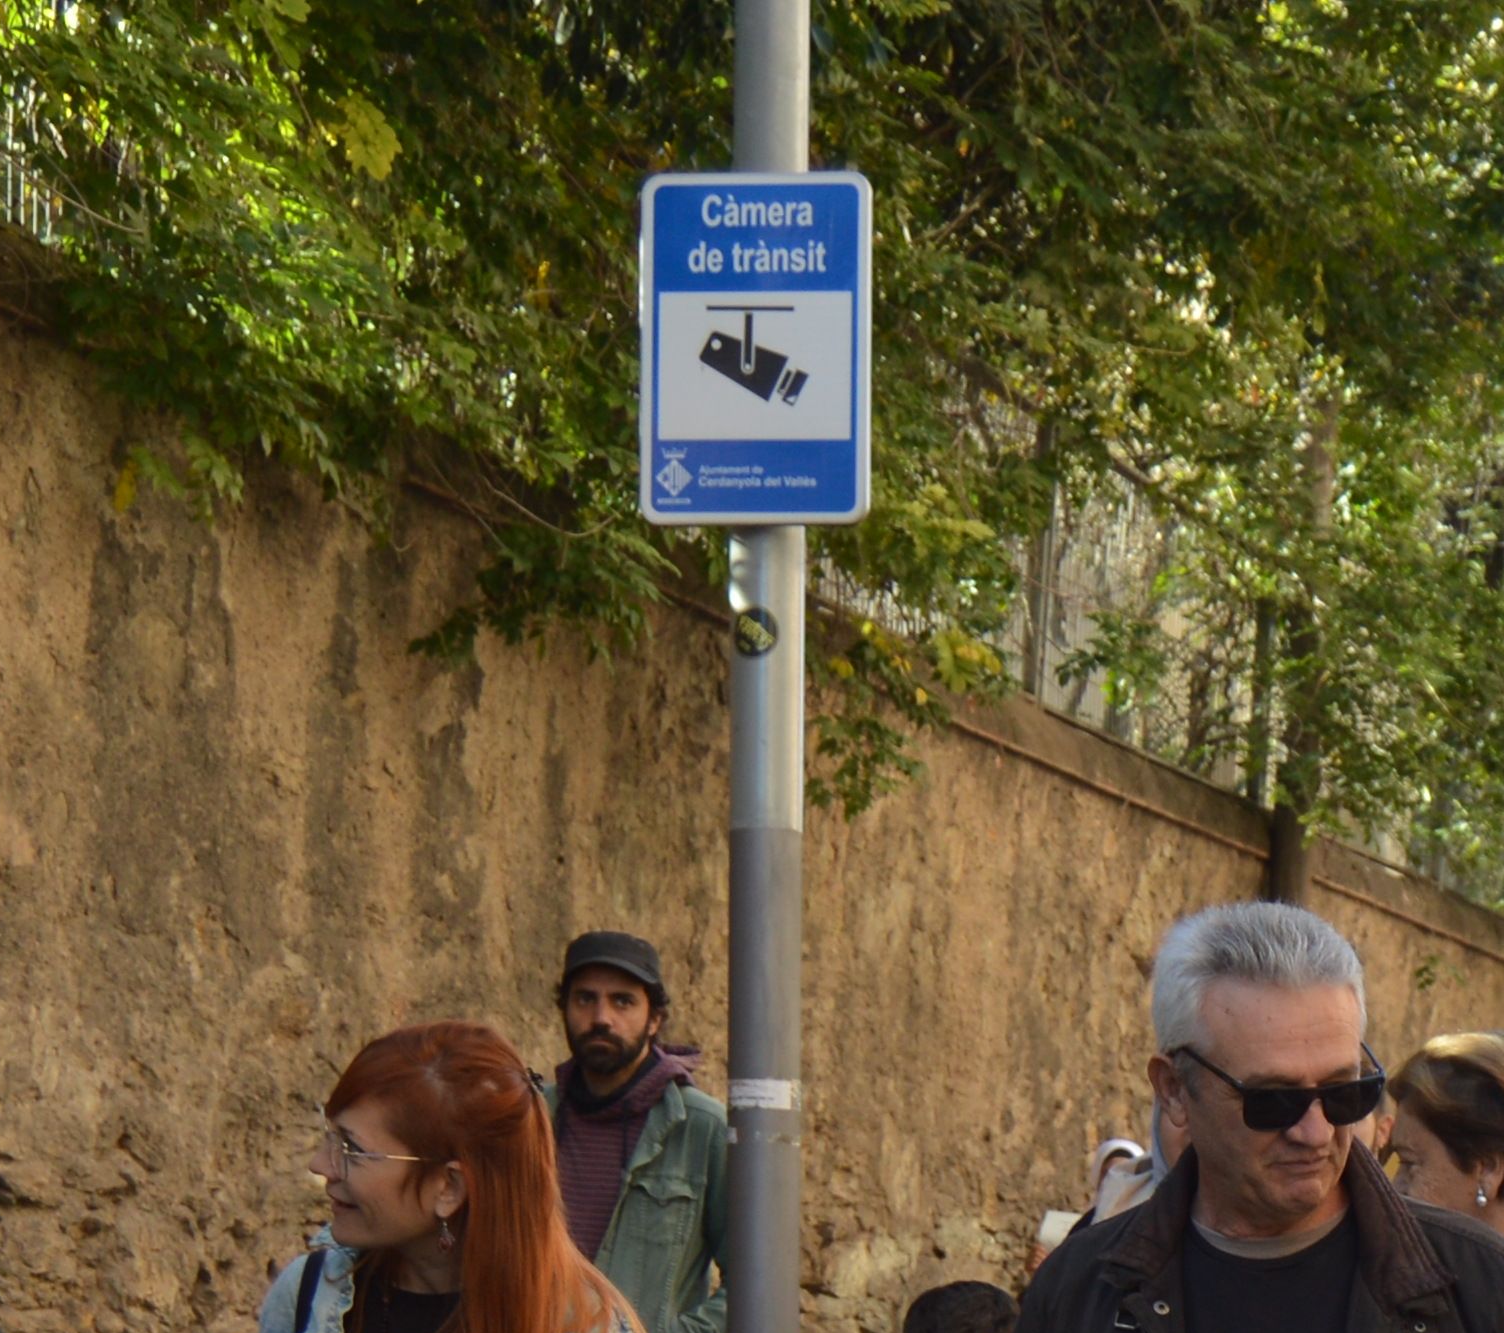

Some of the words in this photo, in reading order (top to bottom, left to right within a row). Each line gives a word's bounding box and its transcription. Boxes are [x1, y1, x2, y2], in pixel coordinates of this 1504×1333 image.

[701, 193, 813, 227] Càmera
[688, 242, 723, 272] de
[732, 240, 826, 273] trànsit
[699, 465, 750, 476] Ajuntament
[752, 465, 764, 474] de
[698, 477, 762, 489] Cerdanyola
[764, 476, 782, 487] del
